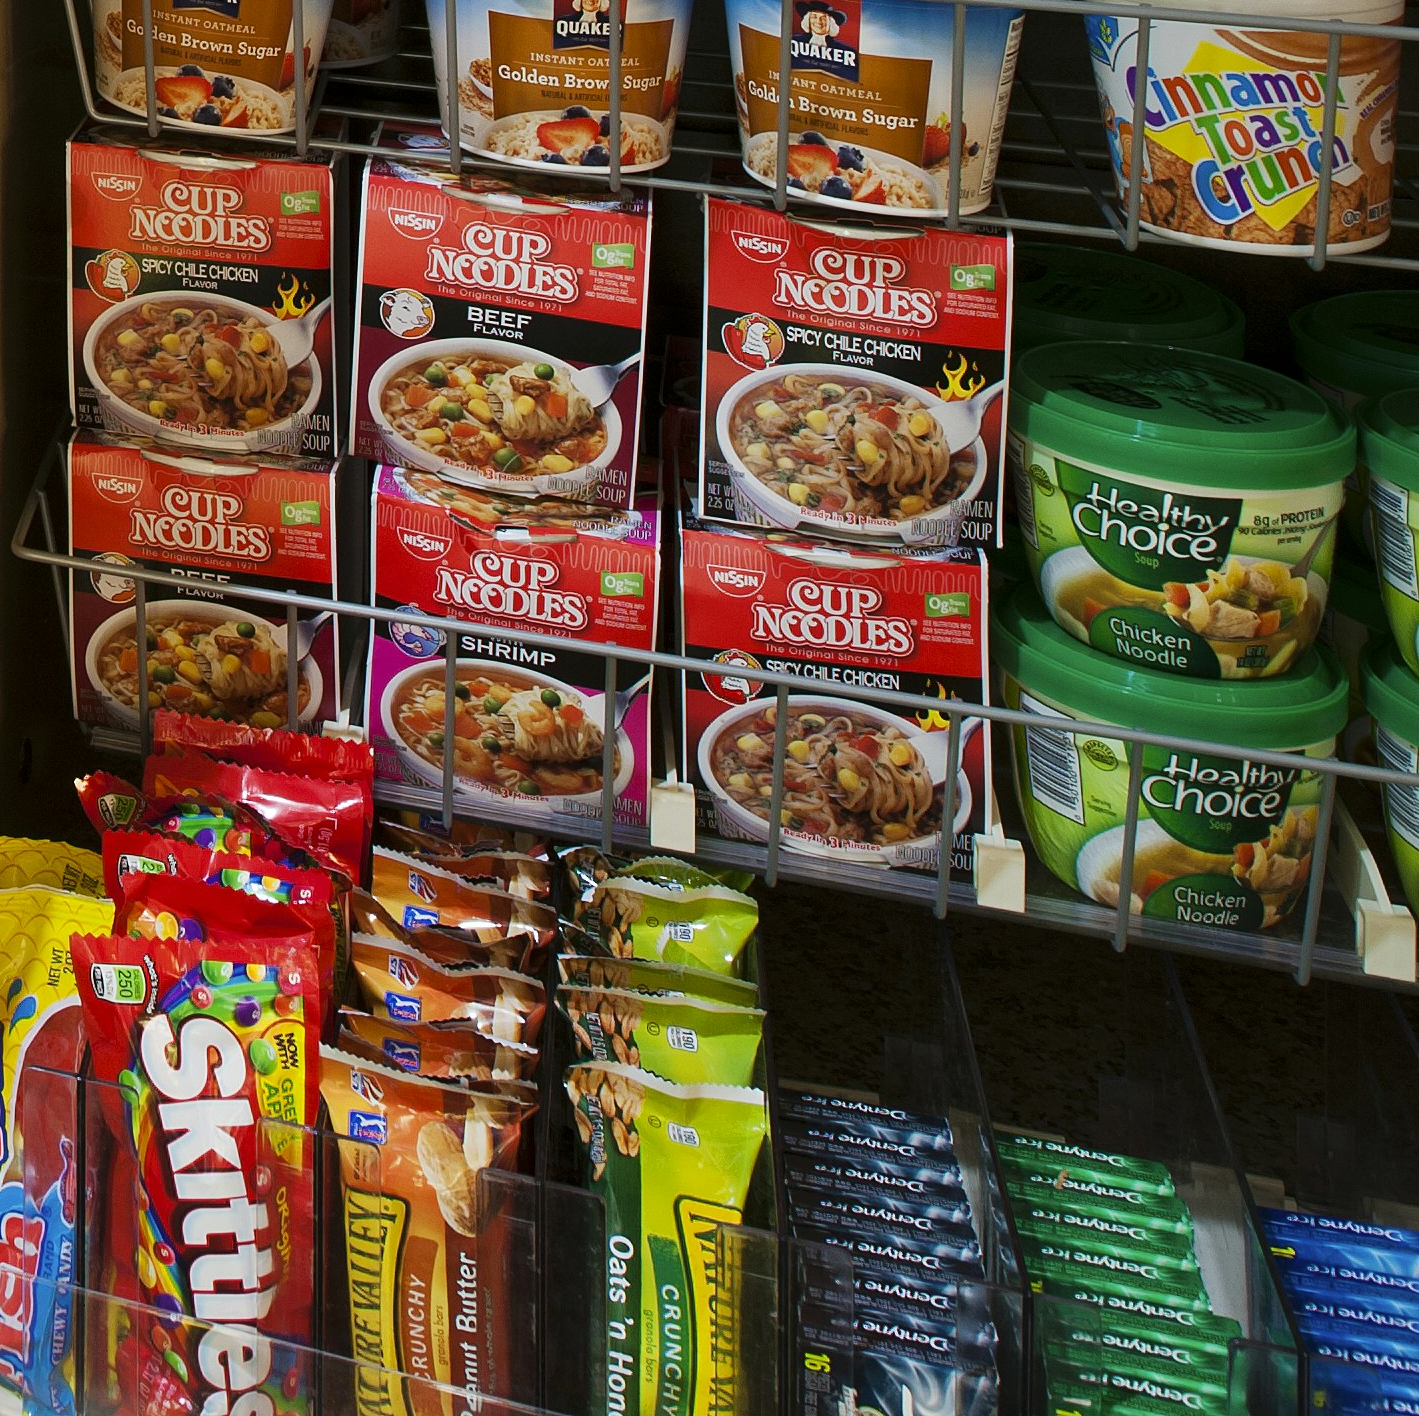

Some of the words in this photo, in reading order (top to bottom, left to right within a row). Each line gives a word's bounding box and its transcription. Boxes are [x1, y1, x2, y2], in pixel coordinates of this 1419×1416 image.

[1127, 67, 1345, 133] Cinnamon
[1196, 107, 1316, 166] Toast
[97, 176, 136, 192] NISSIN
[164, 183, 240, 215] CUP
[130, 207, 268, 249] NOODLES
[394, 213, 436, 231] NISSIN
[466, 225, 548, 262] CUP
[142, 258, 173, 276] SPICY
[175, 263, 208, 279] CHILE
[209, 265, 258, 283] CHICKEN
[182, 278, 218, 290] FLAVOR
[428, 249, 578, 301] NOODLES
[437, 284, 455, 295] The
[459, 288, 502, 304] Original
[506, 296, 535, 308] Since
[540, 301, 562, 312] 1971
[467, 306, 532, 330] BEEF
[473, 324, 524, 340] FLAVOR
[1087, 482, 1229, 534] Healthy
[1280, 507, 1324, 524] PROTEIN
[1072, 500, 1218, 563] Choice
[1134, 552, 1159, 569] Soup
[1109, 617, 1192, 651] Chicken
[461, 636, 556, 666] SHRIMP
[1116, 637, 1189, 670] Noodle
[47, 968, 58, 987] NET
[117, 968, 132, 998] 250
[273, 1033, 287, 1070] WITH
[285, 1032, 299, 1069] NOW
[830, 1098, 907, 1120] Dentyne
[1046, 1142, 1126, 1167] Dentyne
[1318, 1217, 1404, 1241] Dentyne
[350, 1198, 397, 1311] VALLEY
[608, 1235, 634, 1304] Oats
[456, 1252, 477, 1333] Butter
[1109, 1296, 1195, 1325] Dentyne
[408, 1274, 431, 1383] CRUNCHY
